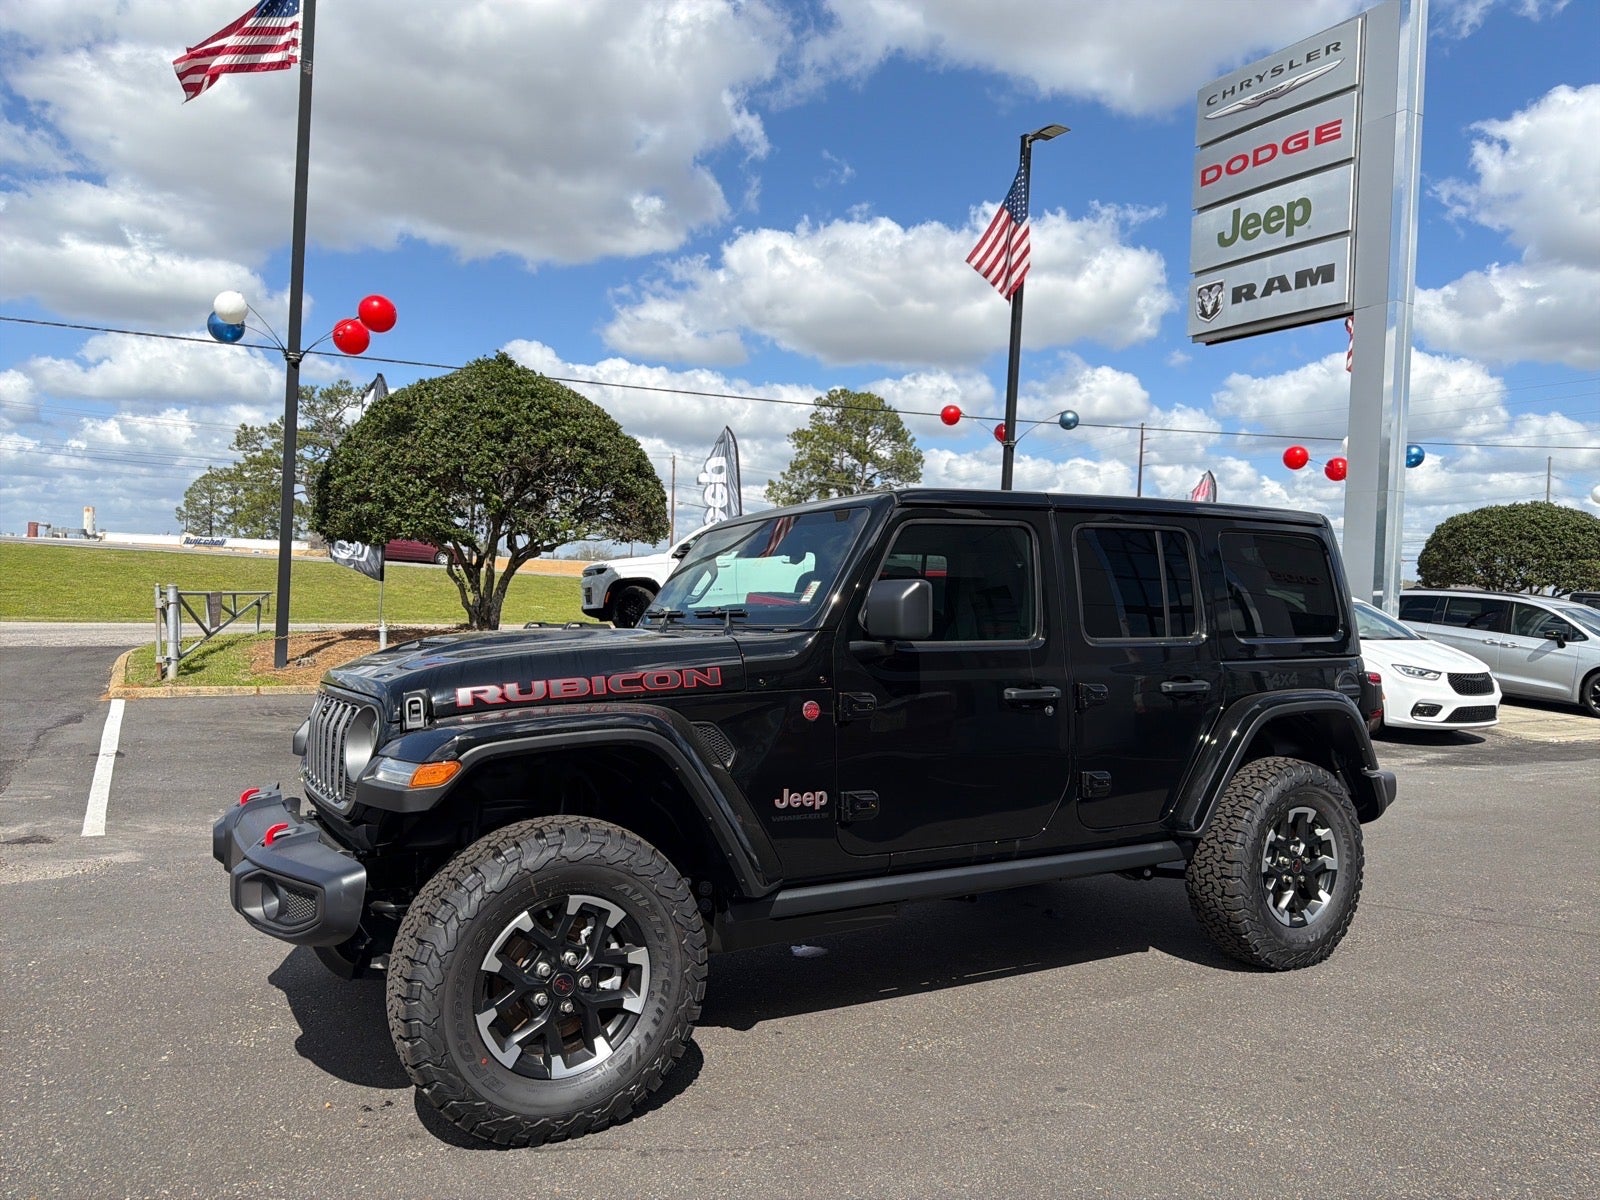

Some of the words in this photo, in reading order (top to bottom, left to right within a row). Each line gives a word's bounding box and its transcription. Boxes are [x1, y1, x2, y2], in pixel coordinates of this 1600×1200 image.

[1207, 41, 1341, 106] CHRYSLER
[1200, 119, 1342, 187] DODGE
[1217, 197, 1311, 247] Jeep
[1231, 263, 1335, 304] RAM
[183, 537, 226, 545] Twitchell
[456, 667, 722, 708] RUBICON
[775, 789, 828, 810] Jeep
